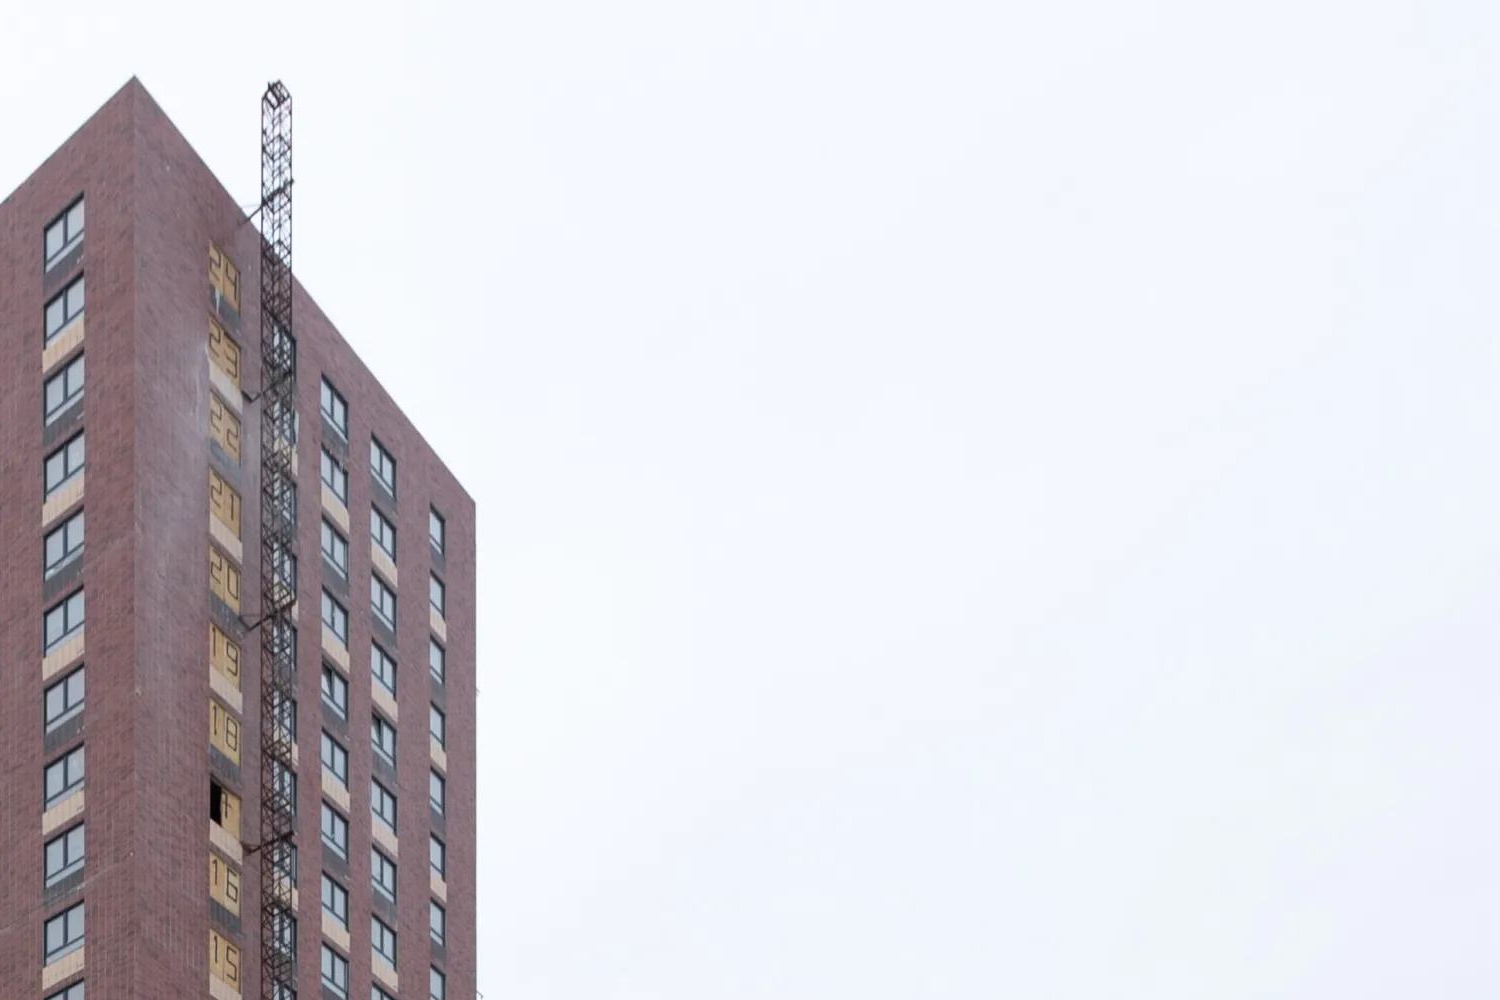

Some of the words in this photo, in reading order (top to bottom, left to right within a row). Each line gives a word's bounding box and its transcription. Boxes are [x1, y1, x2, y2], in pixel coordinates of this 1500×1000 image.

[210, 246, 237, 301] 24
[209, 322, 237, 379] 23
[211, 398, 238, 453] 22
[211, 473, 234, 521] 21
[211, 550, 238, 600] 20
[213, 627, 239, 677] 19
[214, 705, 238, 752] 18
[213, 859, 238, 904] 16
[214, 935, 237, 982] 15
